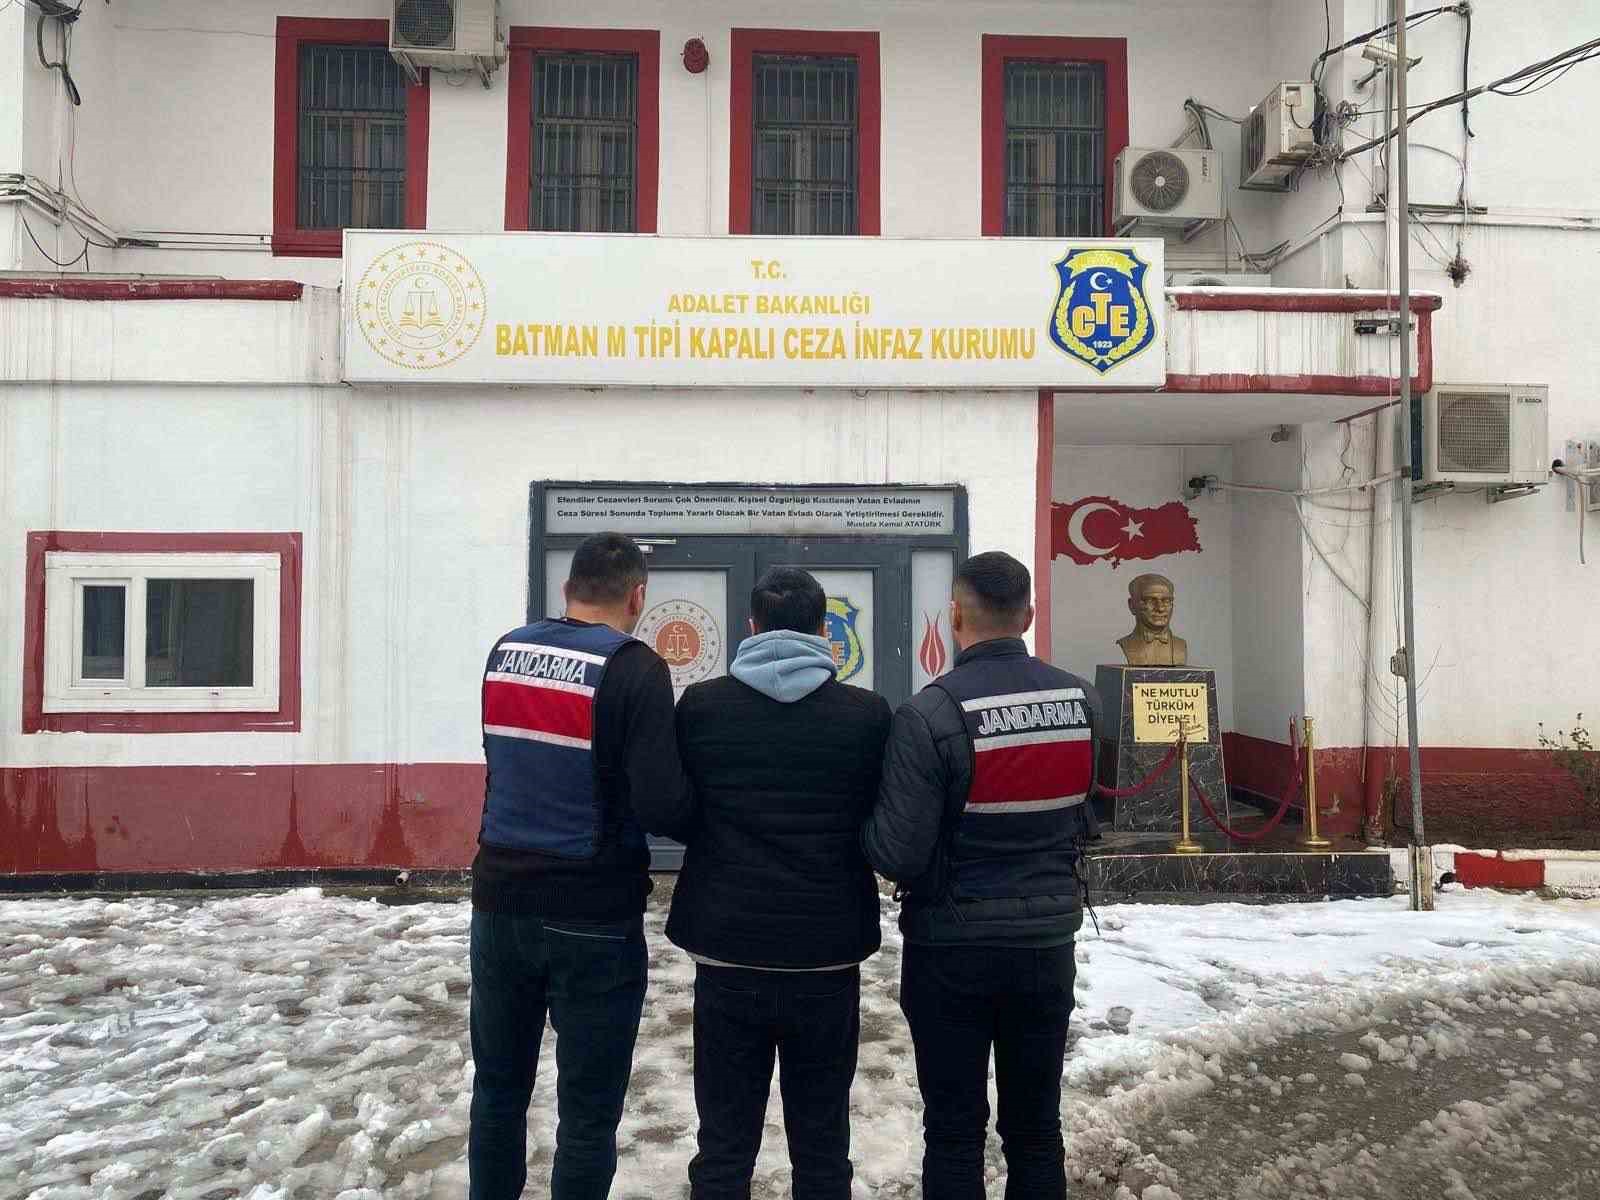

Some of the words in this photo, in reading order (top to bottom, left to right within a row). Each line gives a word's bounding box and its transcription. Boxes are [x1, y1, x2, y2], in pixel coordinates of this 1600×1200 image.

[751, 260, 787, 279] T.C.
[668, 294, 750, 314] ADALET
[756, 292, 870, 315] BAKANLIĞI
[495, 324, 598, 357] BATMAN
[607, 326, 626, 357] M
[634, 319, 681, 358] TİPİ
[689, 327, 776, 360] KAPALI
[783, 327, 847, 360] CEZA
[855, 321, 924, 360] İNFAZ
[931, 327, 1036, 360] KURUMU
[676, 496, 692, 505] Çok
[857, 497, 881, 505] Vatan
[497, 651, 587, 684] JANDARMA
[1141, 688, 1157, 697] NE
[1159, 688, 1199, 697] MUTLU
[1146, 699, 1194, 711] TÜRKÜM
[978, 702, 1087, 735] JANDARMA
